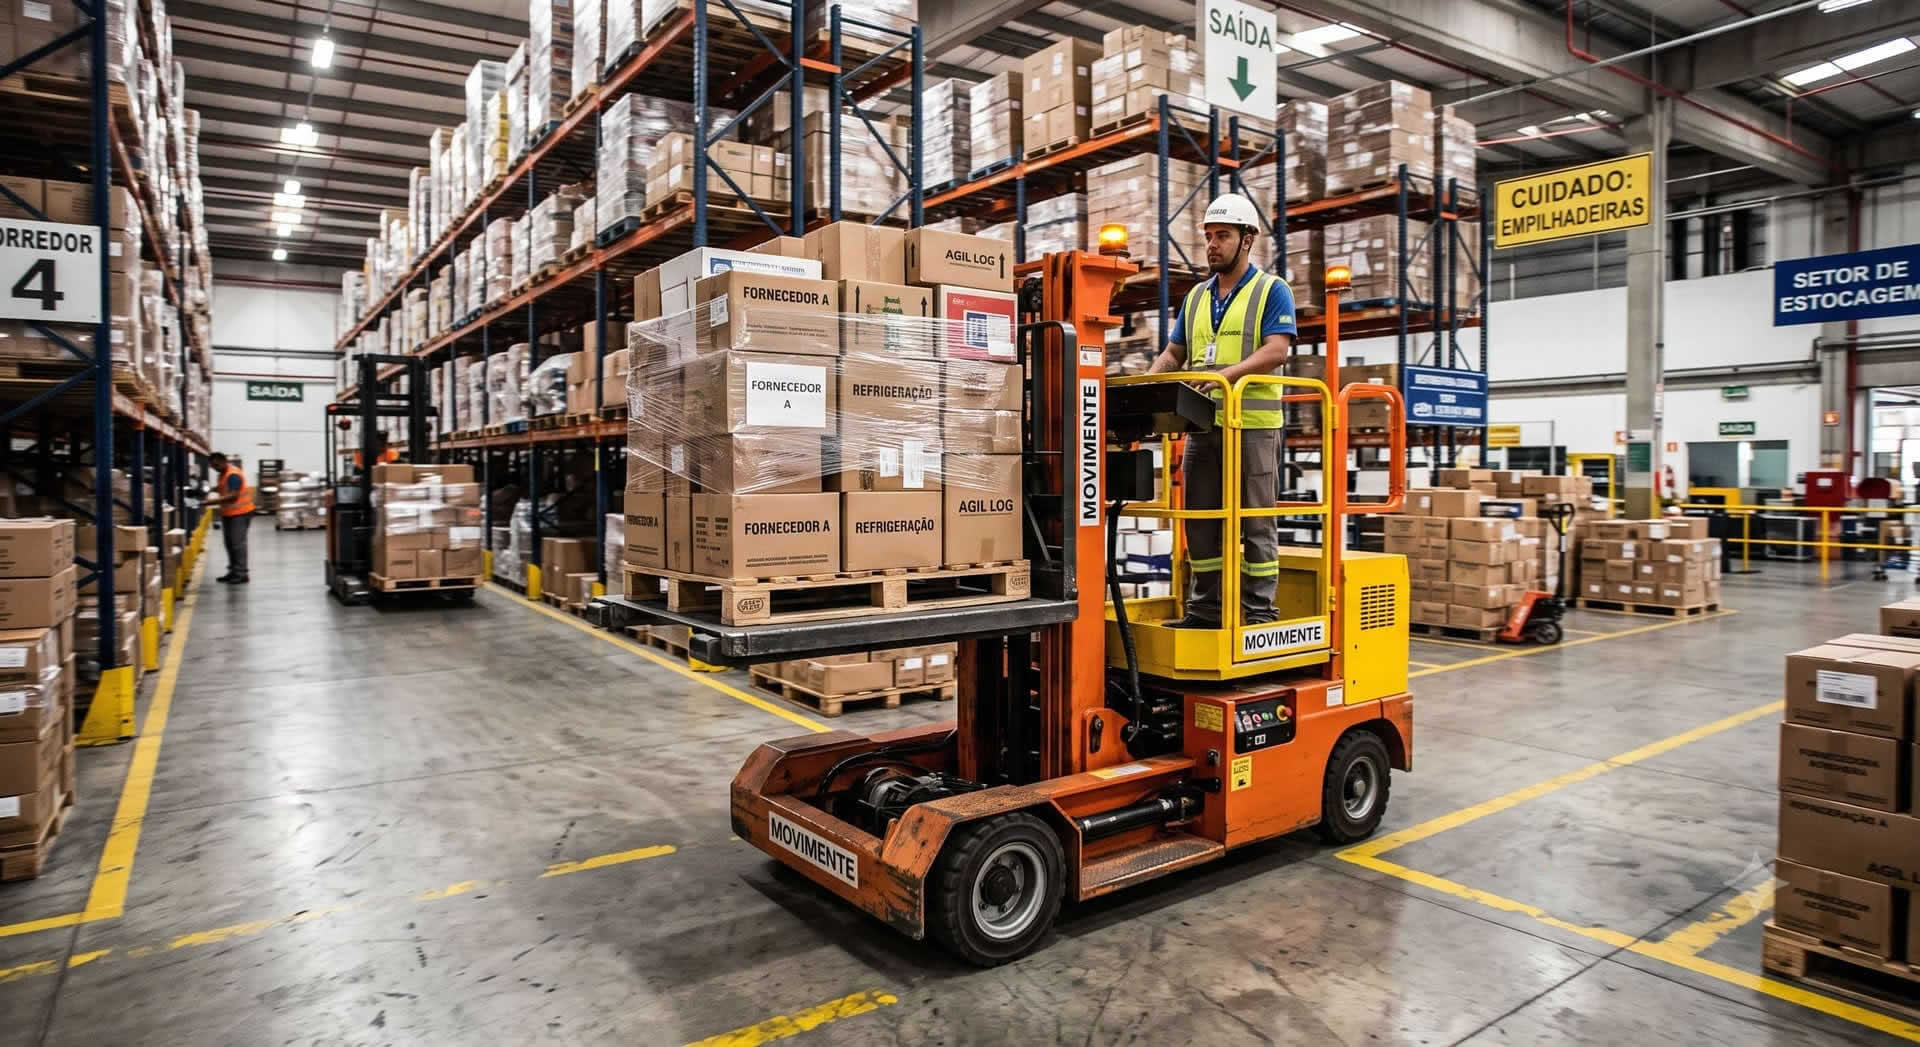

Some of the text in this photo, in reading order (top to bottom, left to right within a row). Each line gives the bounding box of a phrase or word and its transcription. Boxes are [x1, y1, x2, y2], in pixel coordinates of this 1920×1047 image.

[1209, 8, 1273, 52] SAÍDA
[1511, 170, 1632, 208] CUIDADO:
[1501, 197, 1644, 237] EMPILHADEIRAS
[945, 249, 995, 266] AGIL LOG
[11, 258, 65, 311] 4
[1793, 260, 1910, 289] SETOR DE
[743, 286, 830, 306] FORNECEDOR A
[751, 380, 822, 393] FORNECEDOR
[852, 383, 932, 401] REFRIGERAÇÃO
[783, 399, 792, 409] A
[1083, 385, 1097, 519] MOVIMENTE
[959, 499, 1014, 513] AGIL LOG
[744, 520, 831, 536] FORNECEDOR A
[855, 516, 934, 535] REFRIGERAÇÃO
[1244, 625, 1321, 650] MOVIMENTE
[771, 817, 856, 882] MOVIMENTE
